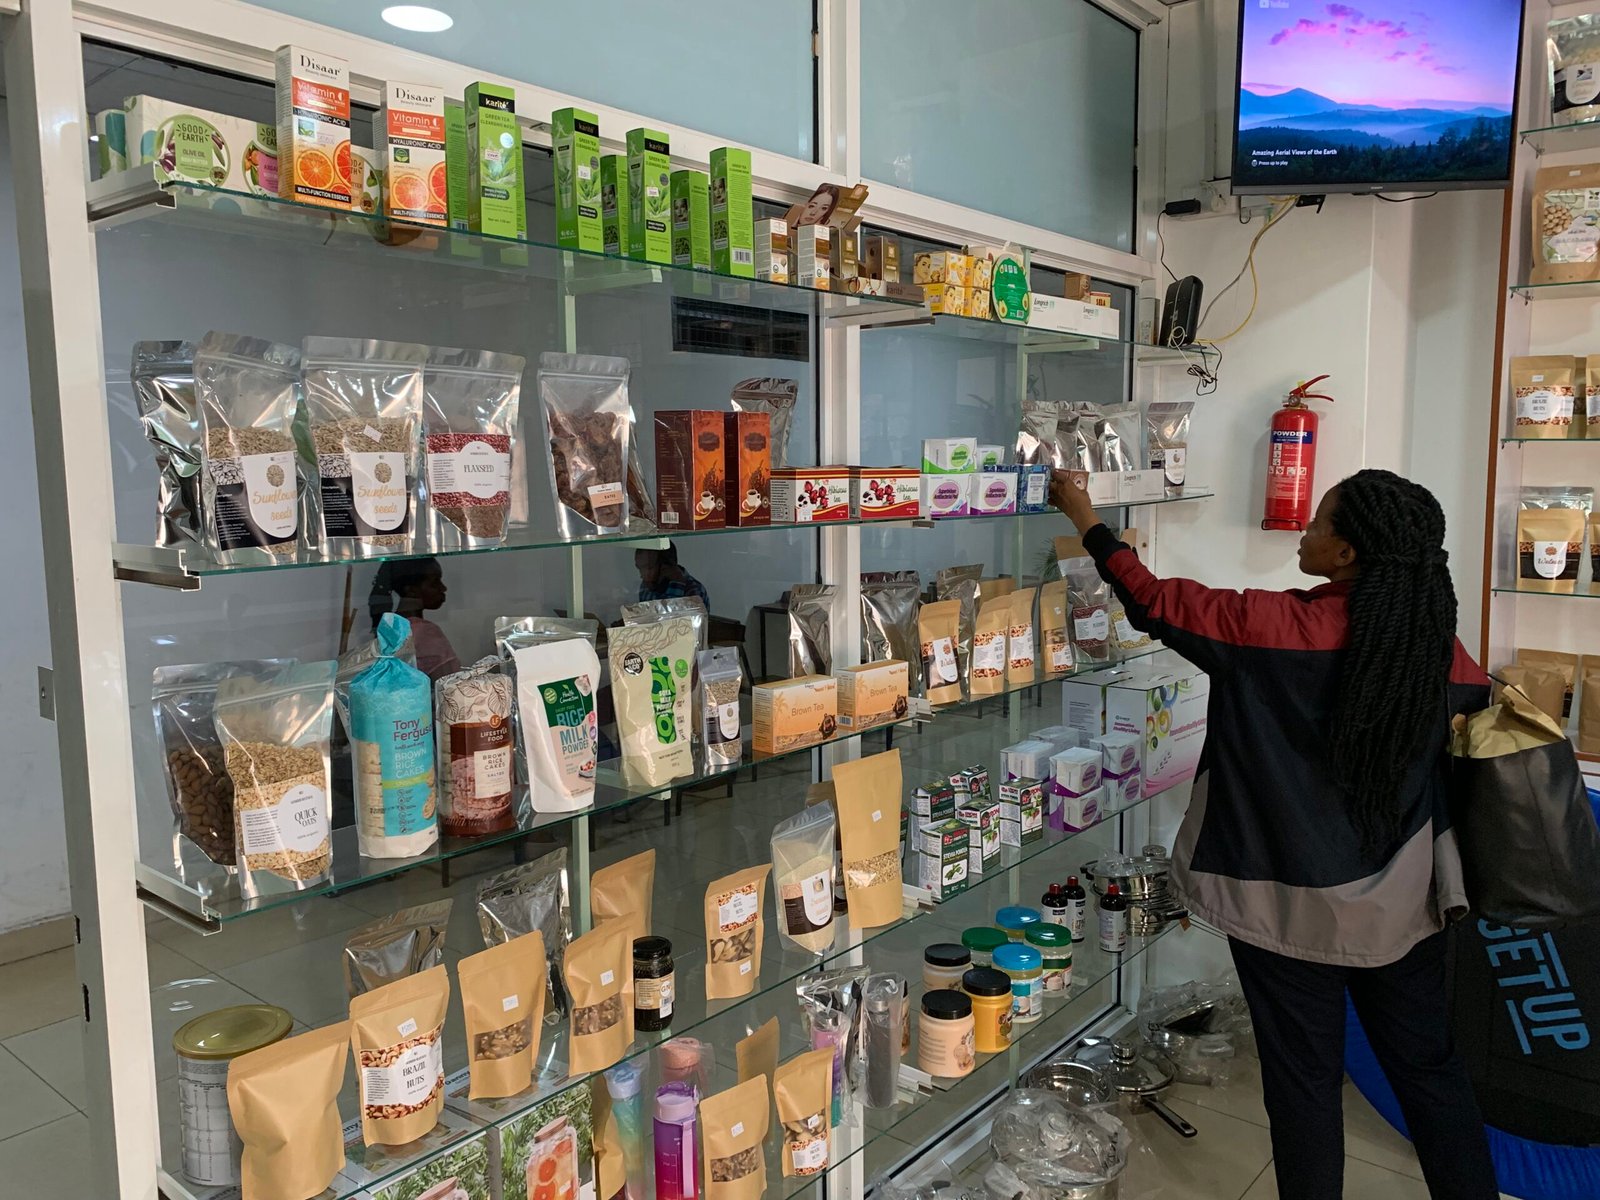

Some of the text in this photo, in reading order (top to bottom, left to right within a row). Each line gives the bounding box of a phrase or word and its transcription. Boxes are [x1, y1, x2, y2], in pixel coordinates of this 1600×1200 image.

[300, 55, 341, 76] Disaar
[395, 88, 435, 104] Disaar
[485, 98, 508, 110] karité
[332, 118, 347, 127] ACID
[393, 112, 430, 125] Vitamin
[181, 124, 204, 135] GOOD
[182, 133, 204, 143] EARTH
[393, 138, 427, 148] HYALURONIC
[330, 193, 349, 202] ESSENCE
[463, 465, 495, 473] FLAXSEED
[828, 484, 847, 494] Hibiscus
[896, 482, 918, 493] Hibiscus
[374, 502, 397, 514] seeds
[271, 509, 292, 521] seeds
[625, 658, 640, 667] EARTH
[871, 684, 898, 698] Brown Tea
[791, 702, 824, 717] Brown Tea
[556, 708, 584, 727] RICE
[393, 718, 420, 731] Tony
[480, 727, 507, 738] LIFESTYLE
[560, 724, 588, 746] MILK
[562, 740, 589, 755] POWDER
[395, 748, 427, 761] BROWN
[482, 753, 506, 761] BROWN
[396, 760, 416, 770] RICE
[396, 766, 424, 779] CAKES
[294, 806, 318, 825] QUICK
[302, 819, 317, 828] OATS
[402, 1062, 426, 1077] BRAZIL
[407, 1075, 425, 1089] NUTS
